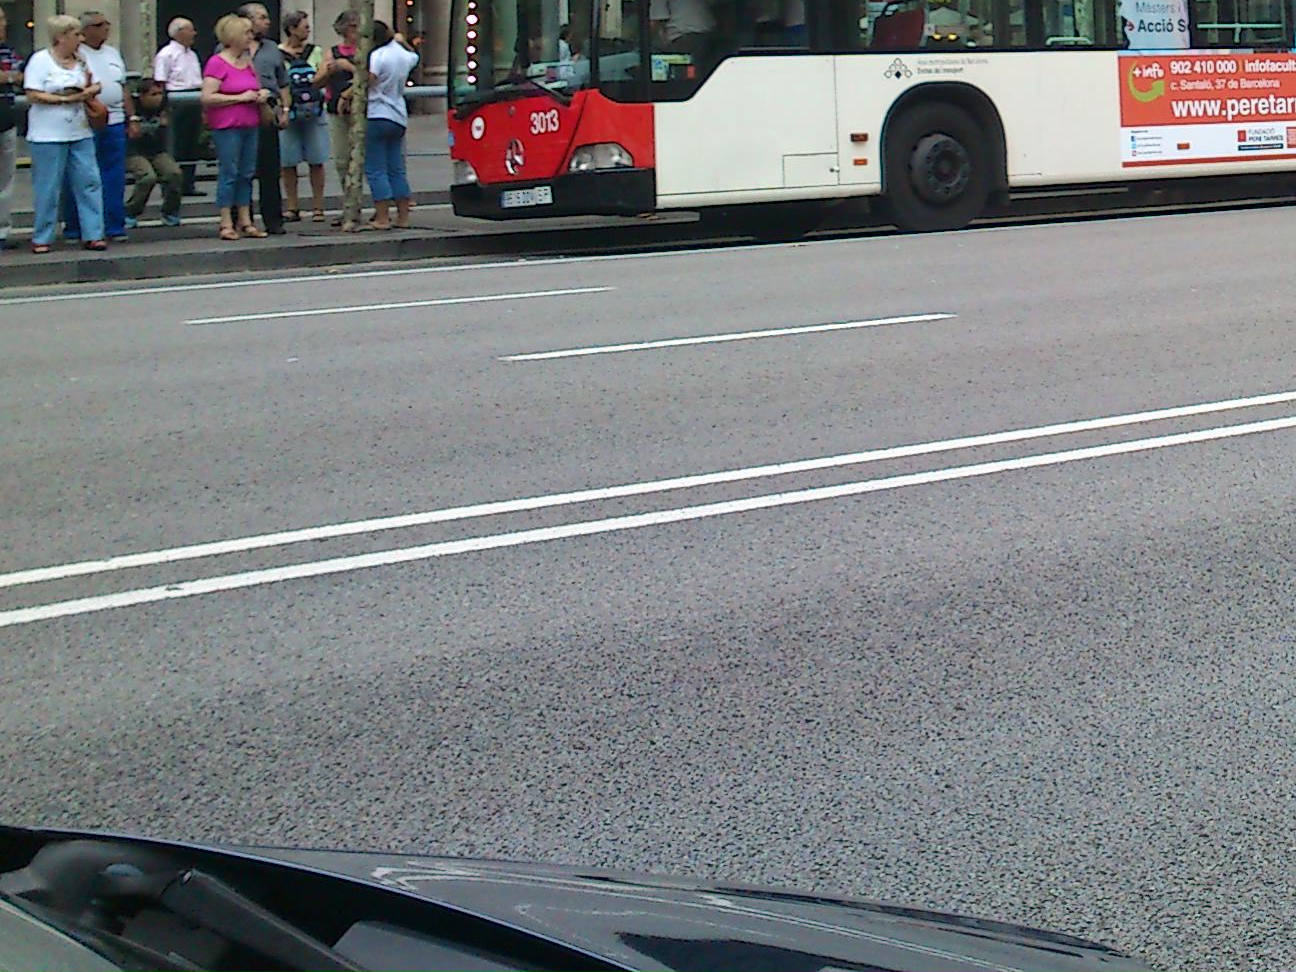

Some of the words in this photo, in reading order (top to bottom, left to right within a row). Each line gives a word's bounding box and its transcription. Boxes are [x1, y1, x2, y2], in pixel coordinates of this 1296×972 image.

[1137, 18, 1175, 33] Acció
[1170, 60, 1192, 74] 902
[1193, 60, 1214, 74] 410
[1215, 60, 1237, 74] 000
[530, 108, 560, 135] 3013
